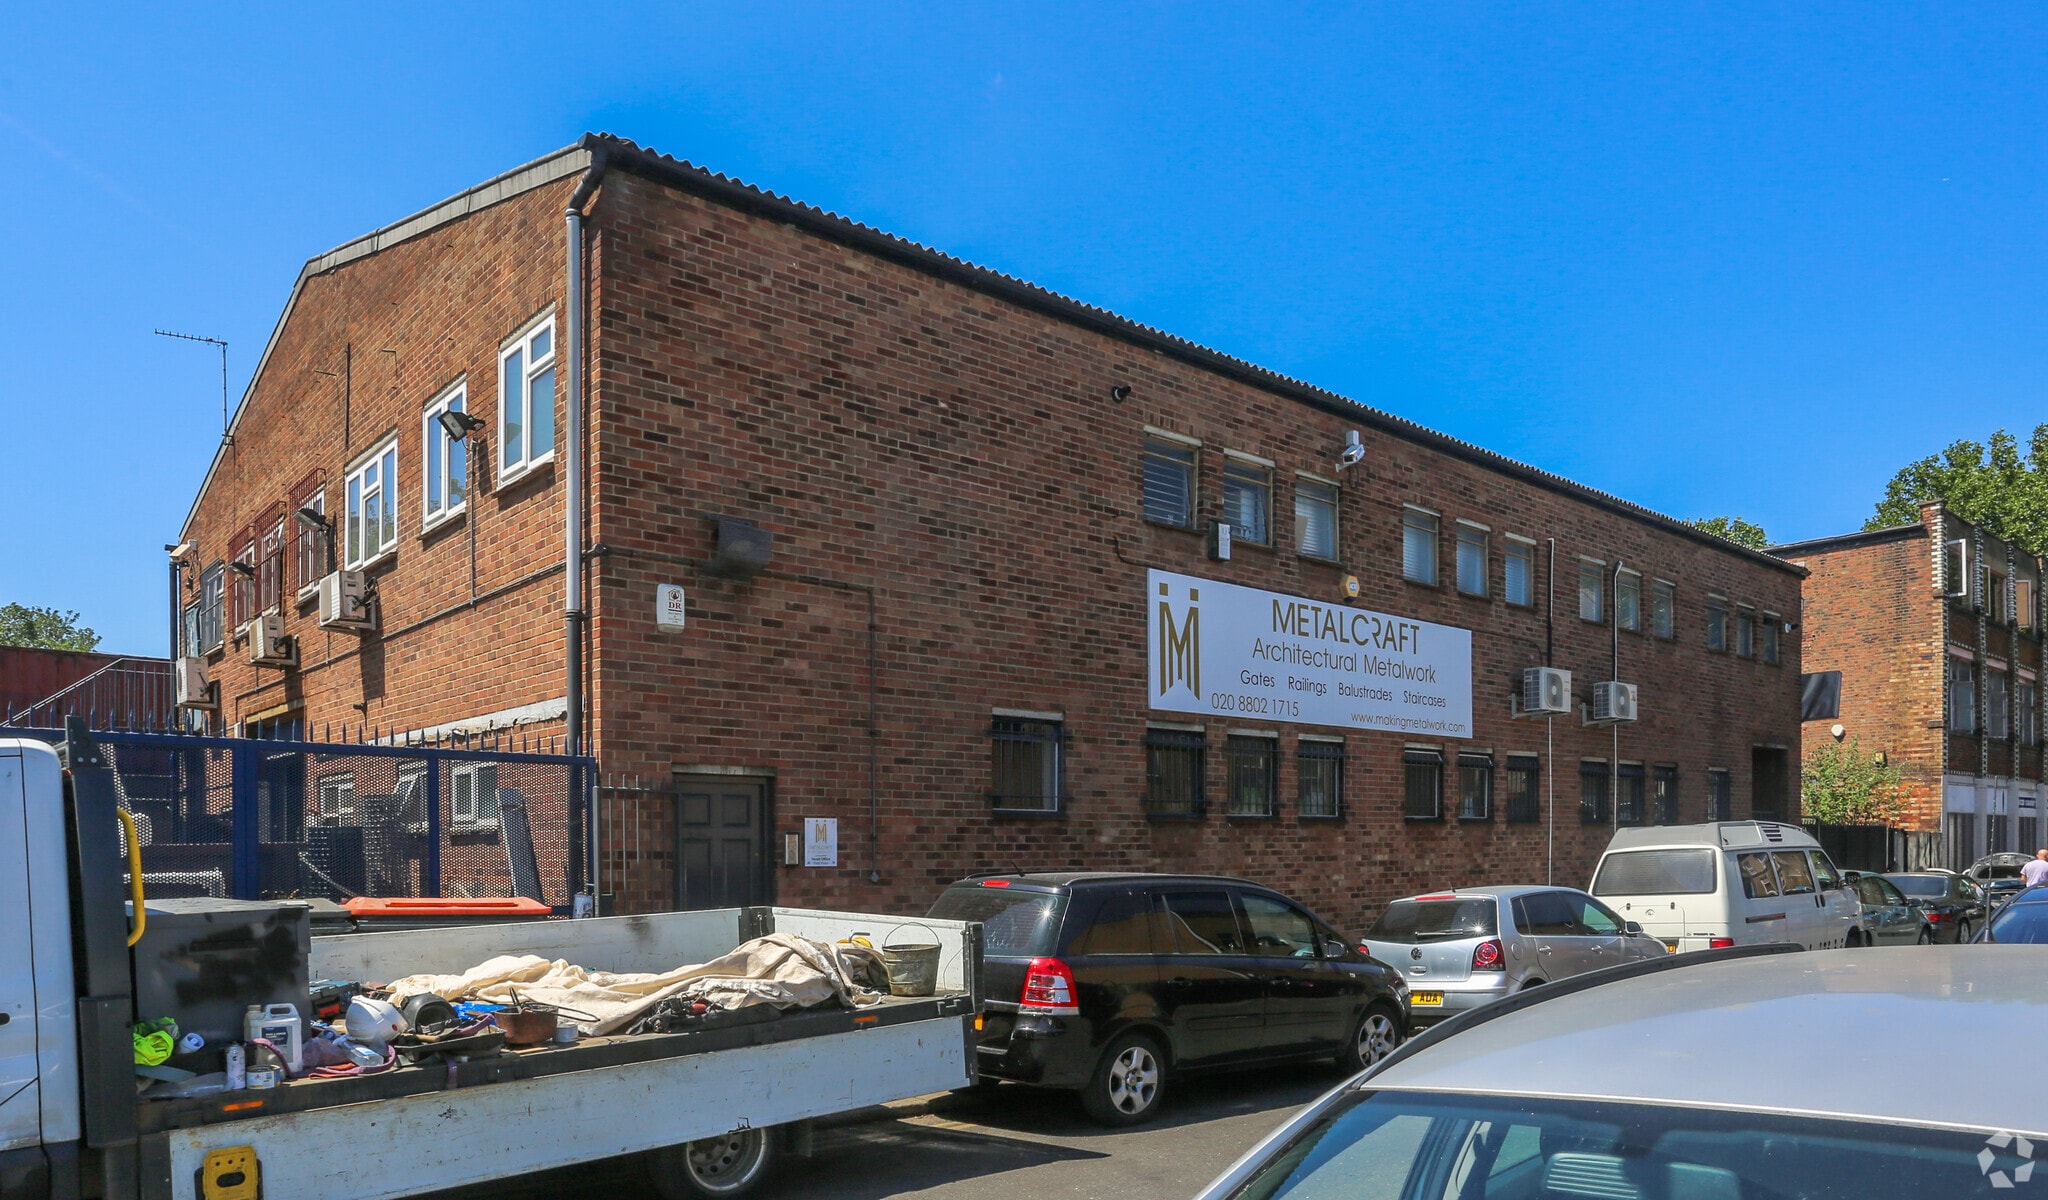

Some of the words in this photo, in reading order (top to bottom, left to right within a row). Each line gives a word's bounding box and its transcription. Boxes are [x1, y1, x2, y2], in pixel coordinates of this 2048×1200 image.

[668, 601, 682, 610] DR
[1272, 598, 1420, 655] METALCRAFT
[1252, 637, 1357, 673] Architectural
[1364, 653, 1437, 684] Metalwork
[1211, 692, 1235, 711] 020
[1238, 695, 1268, 714] 8802
[1272, 698, 1300, 717] 1715
[1240, 669, 1276, 688] Gates
[1288, 675, 1328, 697] Railings
[1338, 682, 1393, 702] Balustrades
[1403, 690, 1447, 708] Staircases
[1351, 713, 1466, 733] www.makingmetalwork.com
